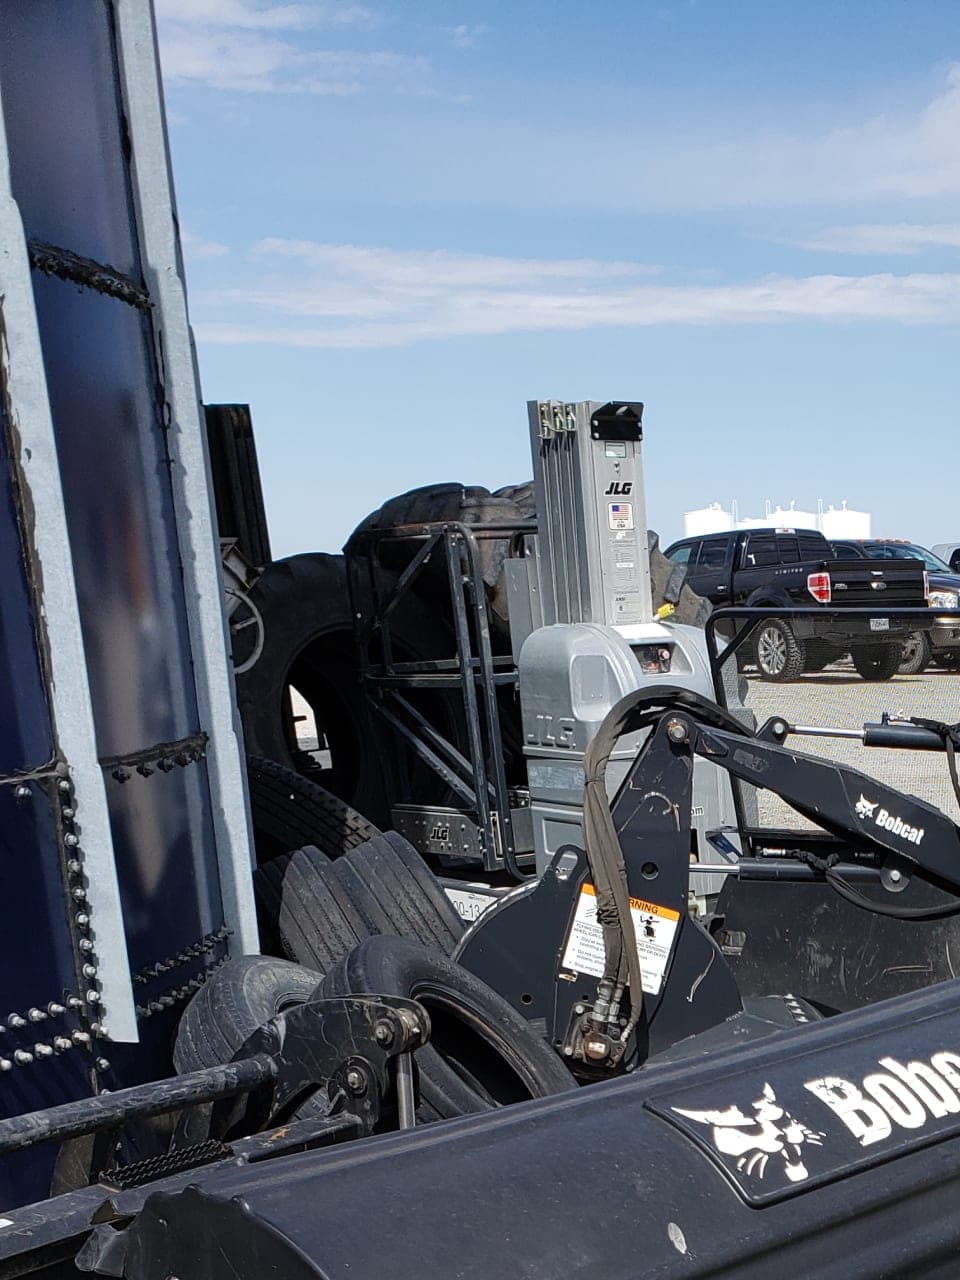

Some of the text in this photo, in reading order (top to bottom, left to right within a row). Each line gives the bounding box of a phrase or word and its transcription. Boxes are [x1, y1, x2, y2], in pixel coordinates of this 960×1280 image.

[604, 482, 633, 496] JLG
[527, 715, 575, 747] JLG
[430, 827, 449, 841] JLG
[875, 808, 925, 846] Bobcat
[629, 898, 660, 915] RNING
